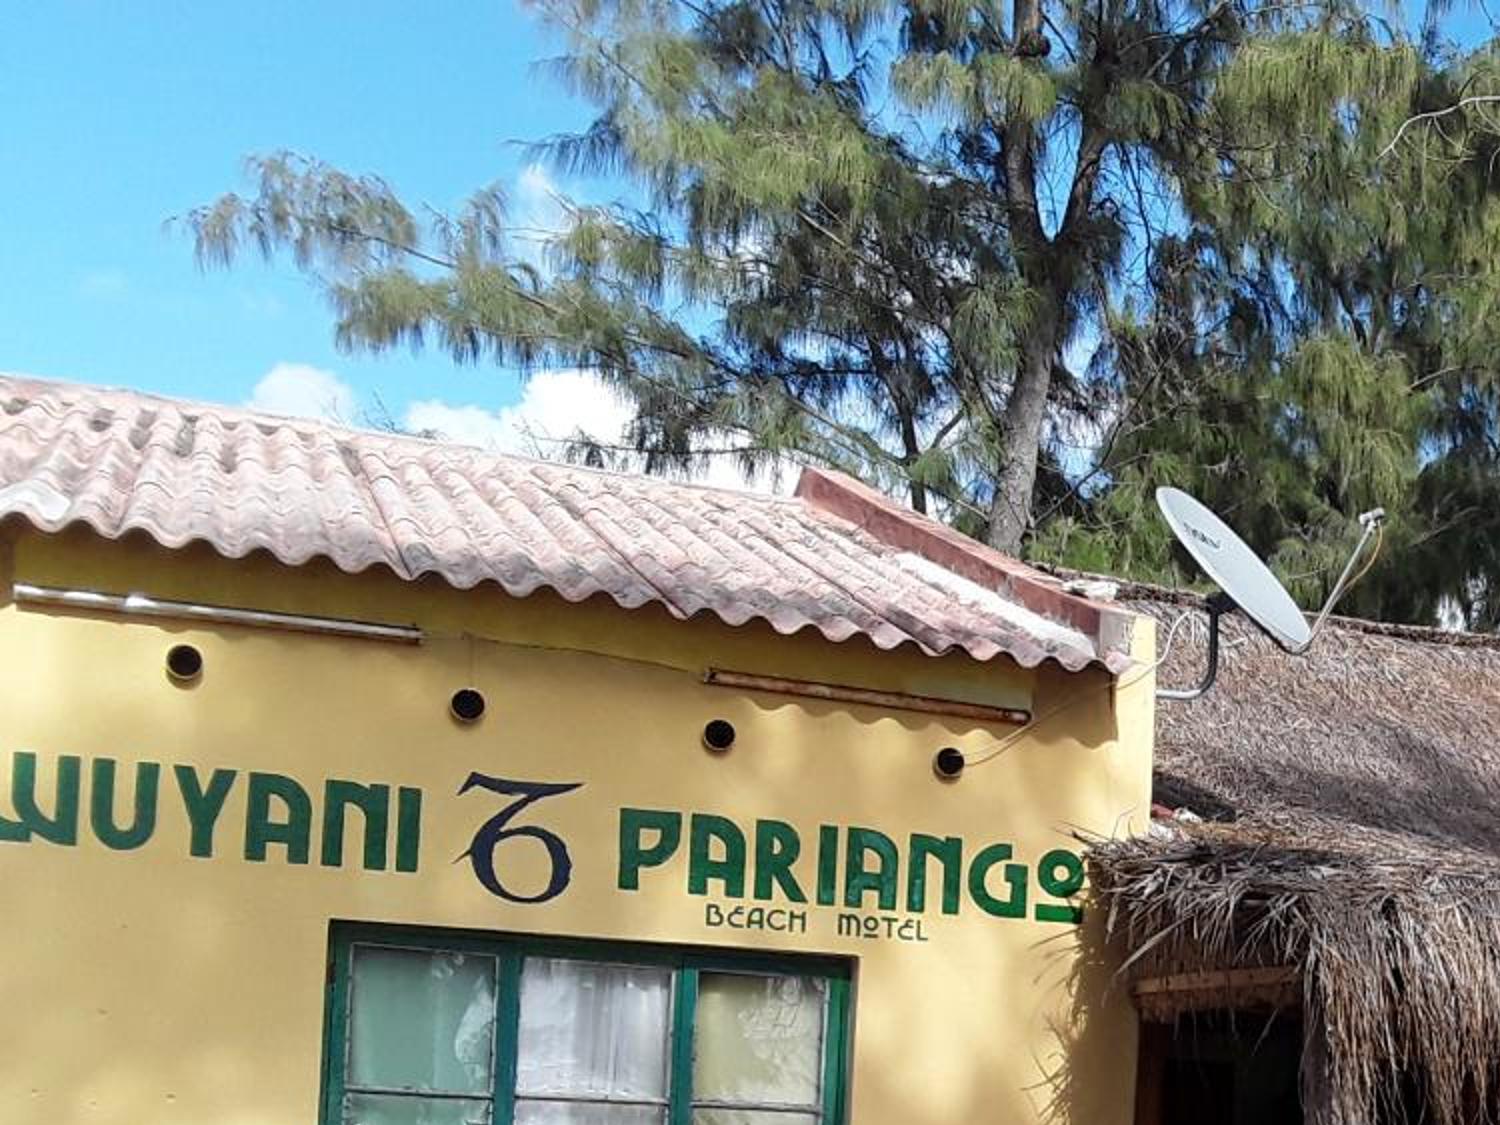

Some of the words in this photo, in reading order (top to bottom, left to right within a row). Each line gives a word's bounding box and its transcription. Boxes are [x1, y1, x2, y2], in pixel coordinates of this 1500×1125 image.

[617, 806, 1085, 924] PARIANGO
[705, 903, 807, 934] BEACH
[837, 913, 929, 942] MOTEL
